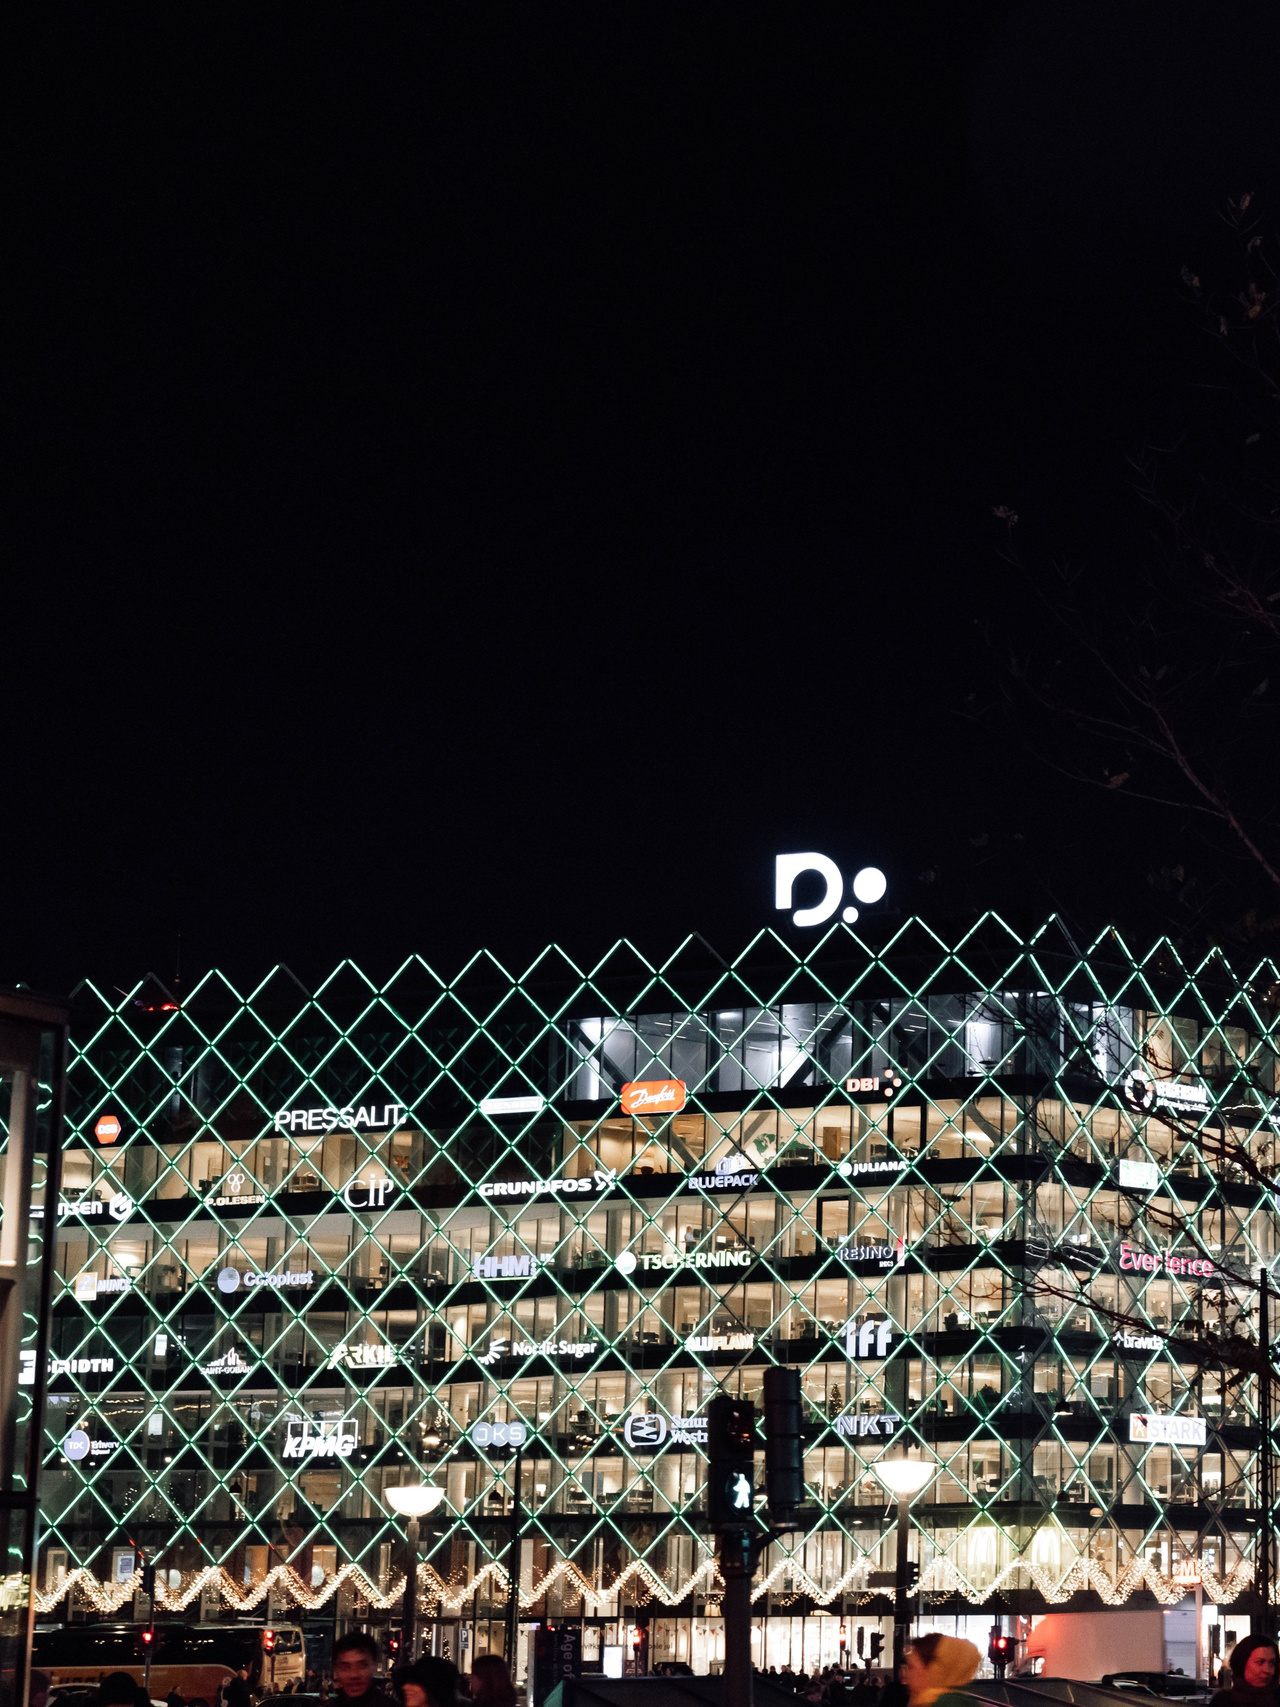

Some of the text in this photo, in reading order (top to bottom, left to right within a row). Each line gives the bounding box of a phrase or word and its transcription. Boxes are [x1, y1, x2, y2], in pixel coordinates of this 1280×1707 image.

[847, 1077, 879, 1093] DBI
[97, 1122, 118, 1135] DSB
[853, 1160, 908, 1176] JULIANA
[479, 1177, 592, 1197] GRUNDFOS
[688, 1173, 758, 1189] BLUEPACK
[640, 1249, 751, 1272] TSCHERNING
[838, 1245, 893, 1261] RESINO
[474, 1255, 530, 1278] HHM
[243, 1271, 313, 1288] Coloplast
[846, 1319, 893, 1357] iff
[1123, 1334, 1164, 1350] bravida
[512, 1339, 597, 1359] Nordic Sugar
[200, 1365, 253, 1375] SAINT-GOBAIN
[475, 1426, 523, 1440] JKS
[836, 1414, 900, 1435] NKT
[1151, 1418, 1203, 1441] STARK
[68, 1441, 85, 1450] TDC
[283, 1434, 356, 1459] KPMG
[561, 1634, 576, 1679] Age of
